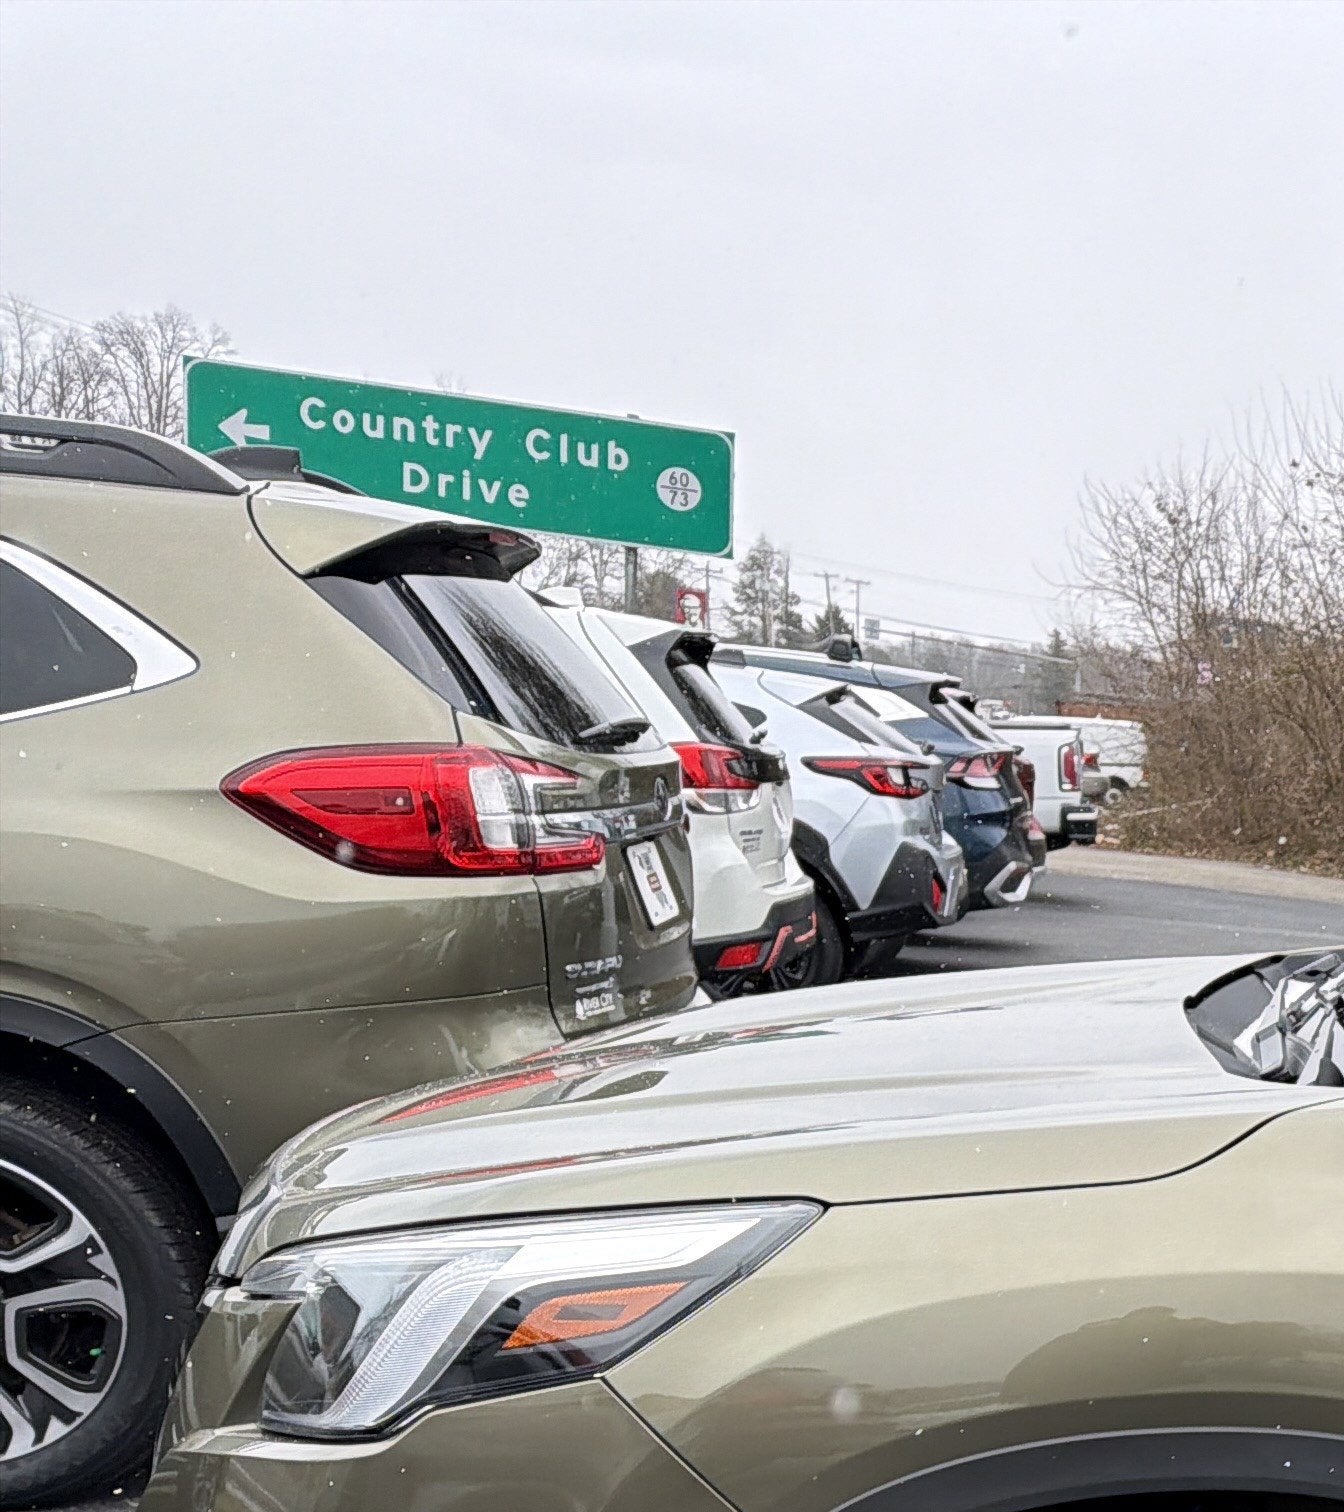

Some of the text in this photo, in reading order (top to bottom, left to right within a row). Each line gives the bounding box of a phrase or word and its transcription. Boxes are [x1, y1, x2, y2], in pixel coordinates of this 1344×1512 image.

[300, 397, 629, 471] Country Club
[402, 461, 530, 508] Drive
[669, 471, 690, 488] 60
[669, 489, 689, 507] 73
